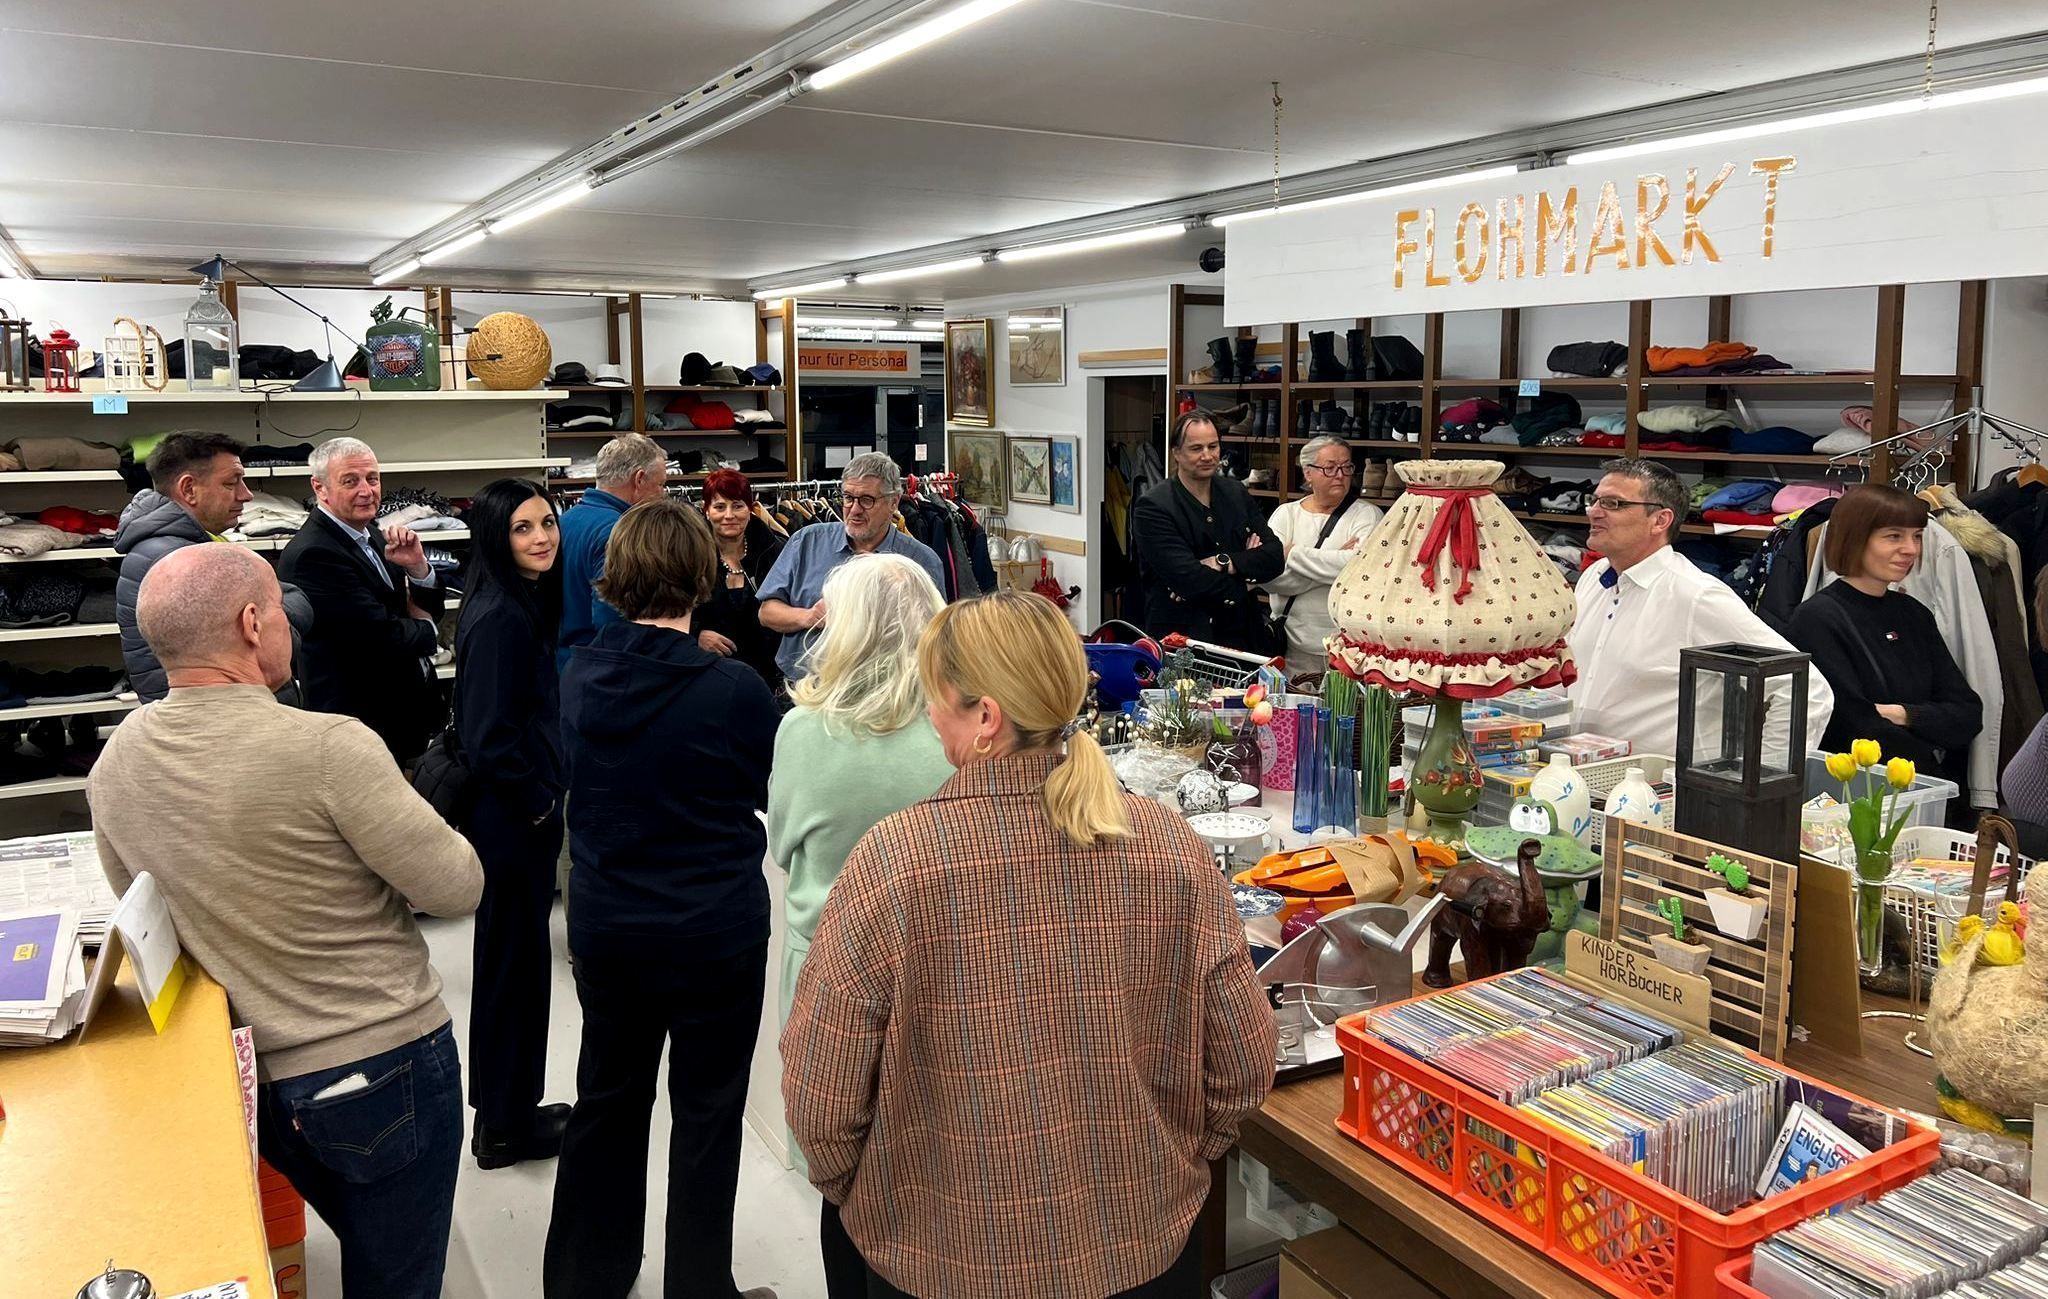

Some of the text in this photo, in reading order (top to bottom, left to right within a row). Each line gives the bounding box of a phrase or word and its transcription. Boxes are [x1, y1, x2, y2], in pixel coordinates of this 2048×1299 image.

[1393, 154, 1799, 290] FLOHMARKT
[798, 352, 908, 368] nur für Personal
[103, 398, 116, 412] M
[1581, 935, 1636, 972] KINDER
[1795, 1127, 1849, 1171] ENGLISC
